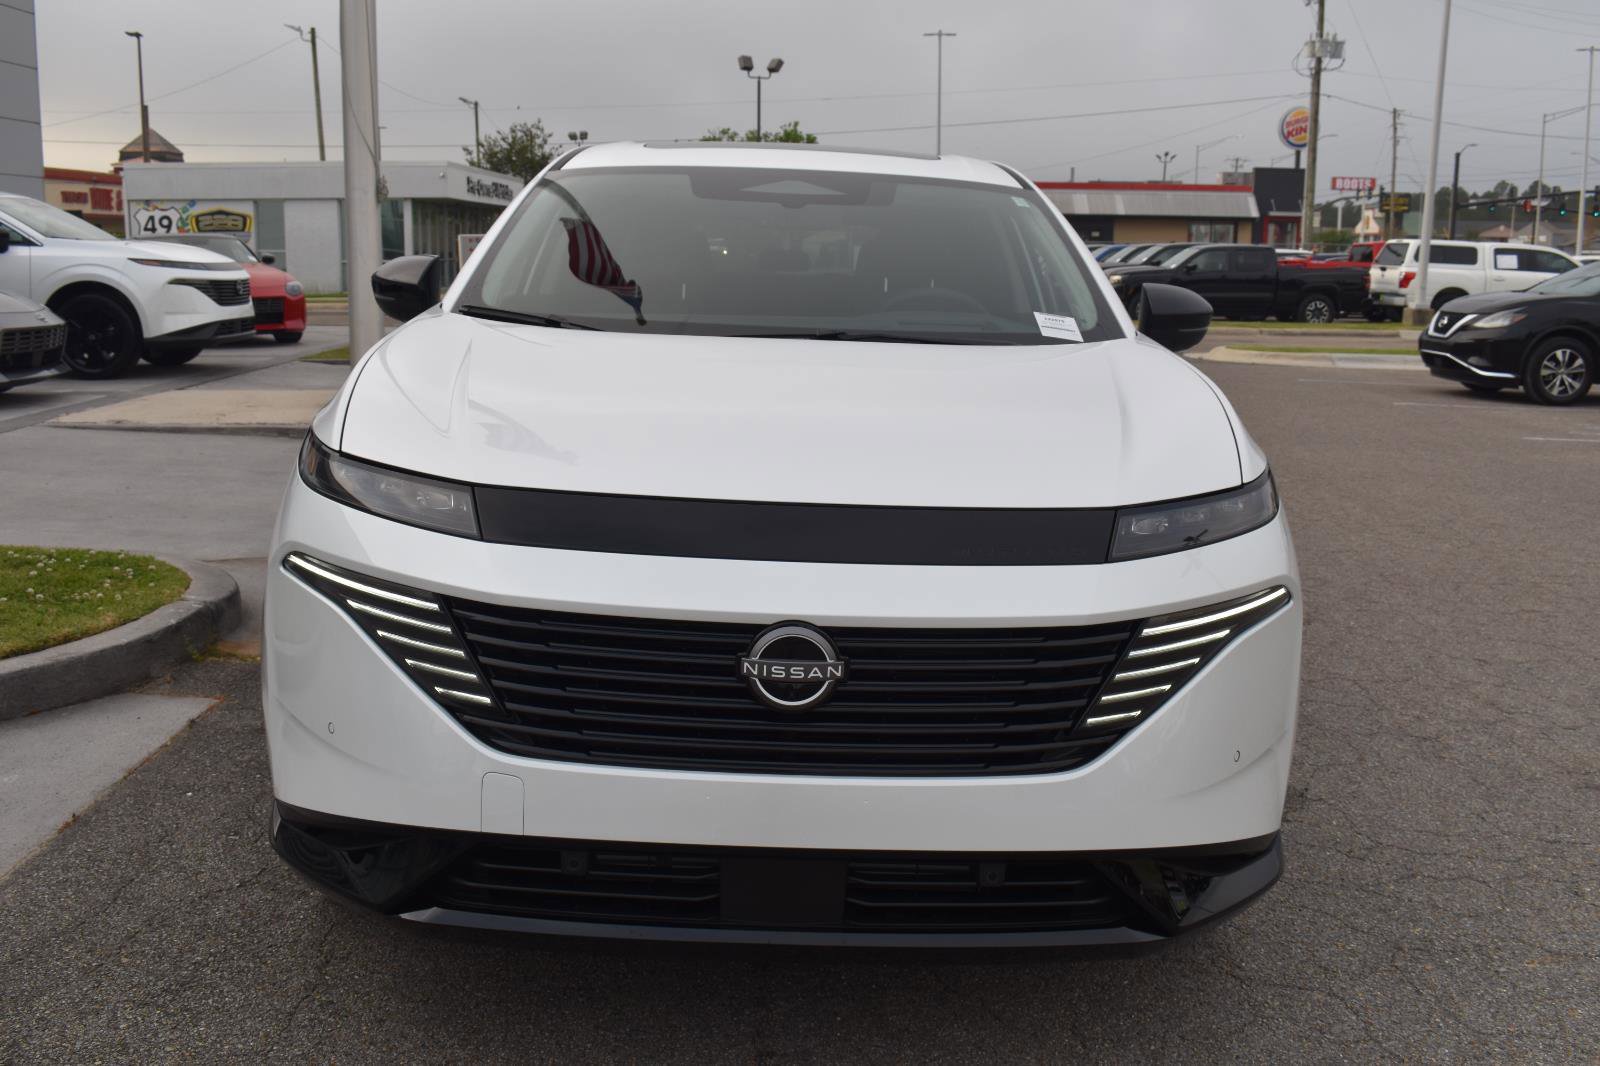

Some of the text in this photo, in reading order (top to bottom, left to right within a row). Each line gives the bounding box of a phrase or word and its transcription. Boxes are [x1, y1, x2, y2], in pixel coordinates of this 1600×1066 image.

[1286, 125, 1308, 138] KIN
[143, 215, 173, 234] 49
[743, 662, 842, 679] NISSAN
